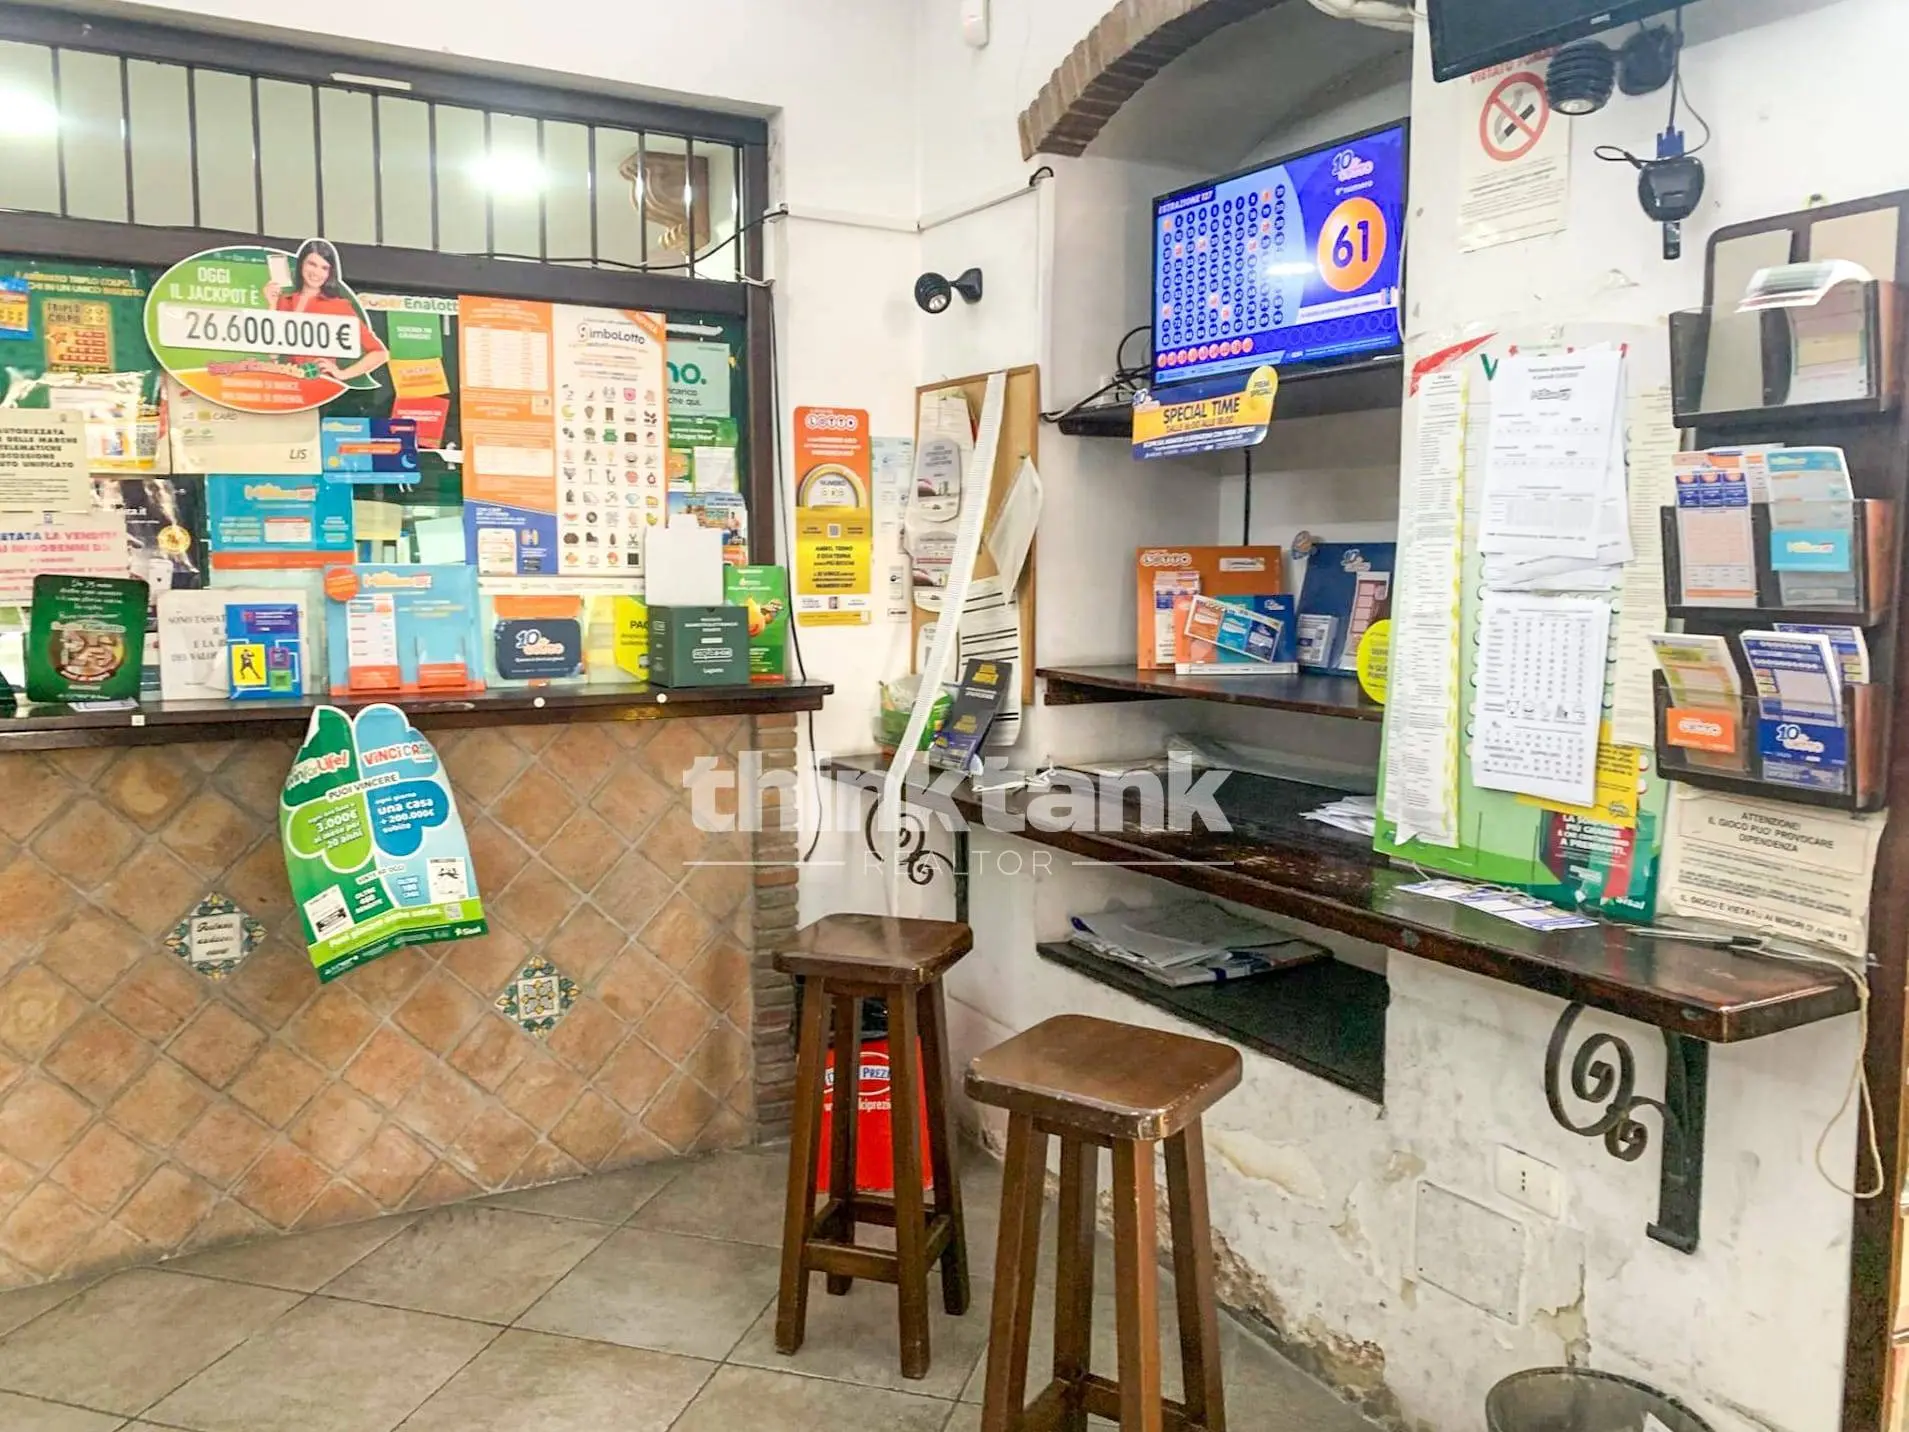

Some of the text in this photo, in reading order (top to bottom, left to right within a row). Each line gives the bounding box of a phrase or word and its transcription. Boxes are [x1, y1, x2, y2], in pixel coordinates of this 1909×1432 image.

[1332, 220, 1370, 269] 61
[197, 266, 230, 284] OGGI
[169, 282, 183, 300] IL
[187, 283, 248, 304] JACKPOT
[185, 310, 352, 350] 26.600.000 €
[1163, 397, 1241, 425] SPECIAL TIME
[377, 797, 434, 816] una casa
[1719, 818, 1748, 833] GIOCO
[1776, 830, 1835, 850] PROVOCARE
[1738, 832, 1799, 853] DIPENDENZA
